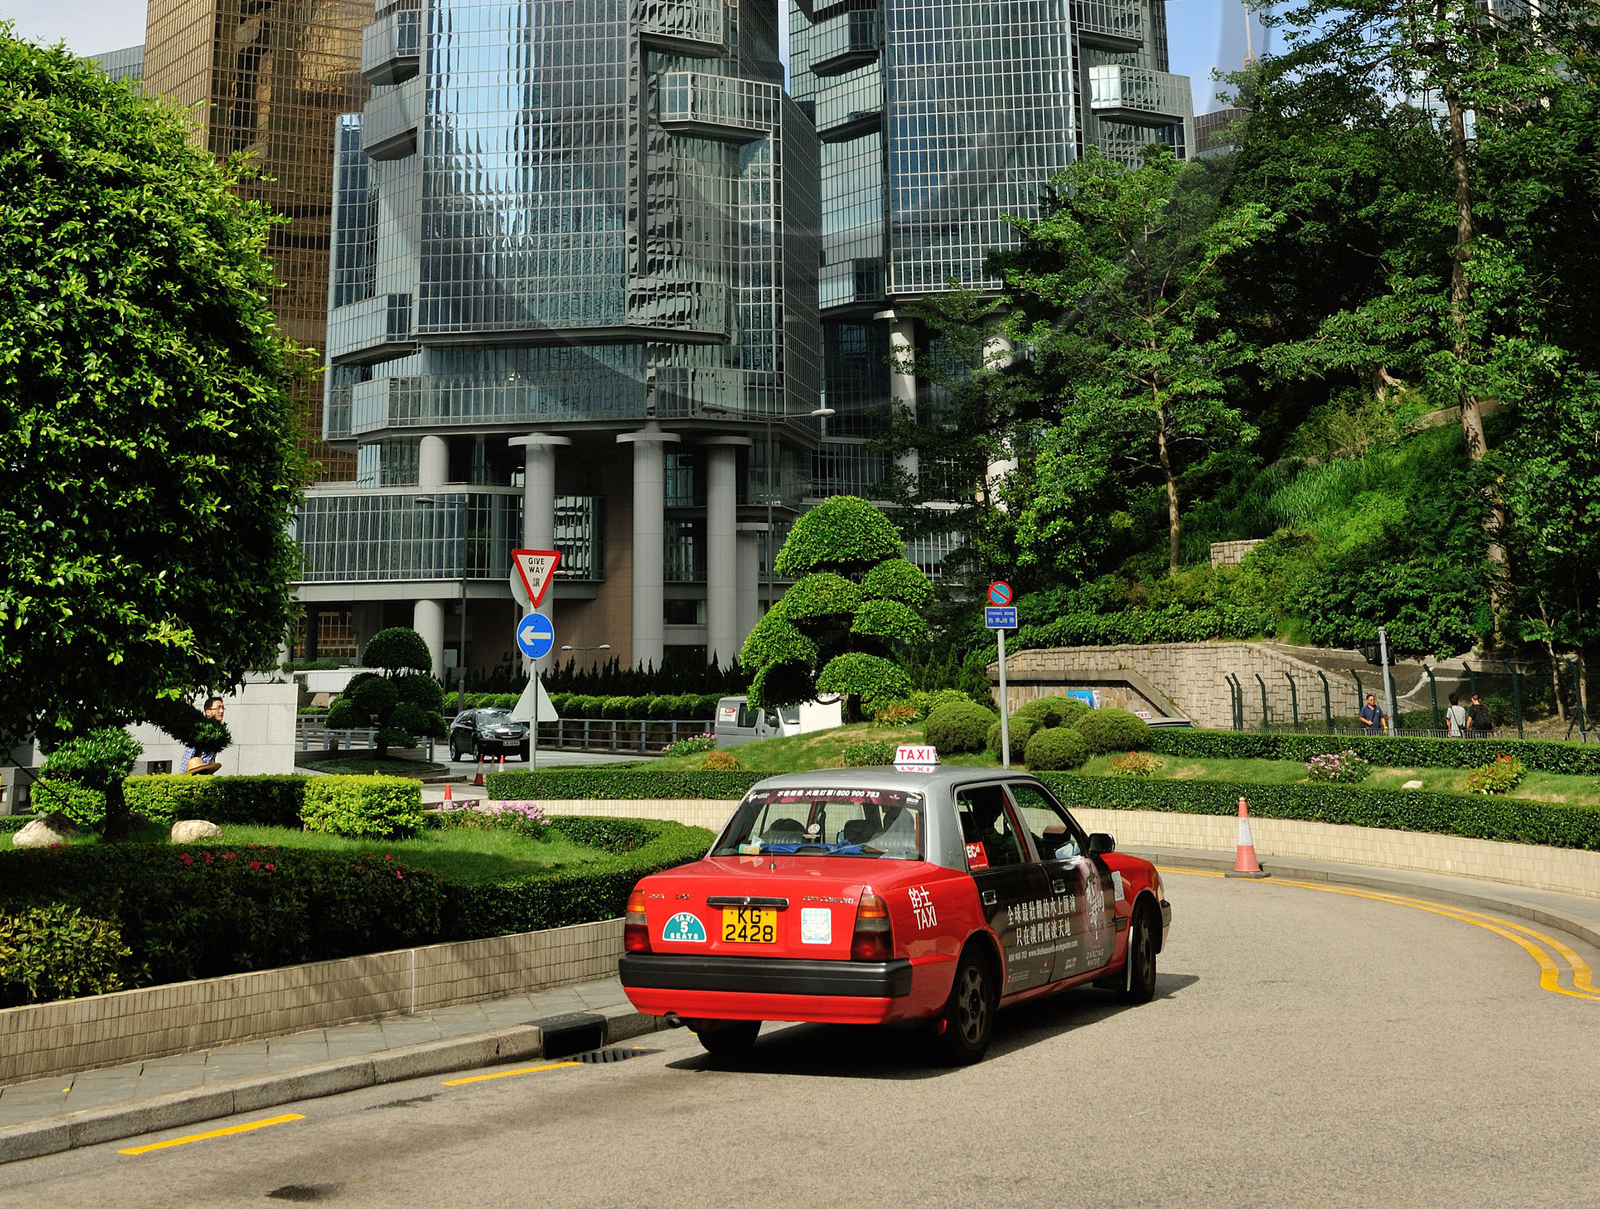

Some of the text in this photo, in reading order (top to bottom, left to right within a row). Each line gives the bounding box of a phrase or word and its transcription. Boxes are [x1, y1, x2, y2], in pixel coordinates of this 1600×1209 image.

[528, 557, 545, 565] GIVE
[528, 566, 545, 574] WAY
[899, 749, 930, 760] TAXI
[908, 885, 932, 909] 的士
[674, 914, 695, 924] TAXI
[737, 906, 762, 925] KG
[913, 905, 937, 930] TAXI
[680, 921, 689, 934] 5
[725, 924, 774, 943] 2428
[670, 932, 699, 941] SEATS
